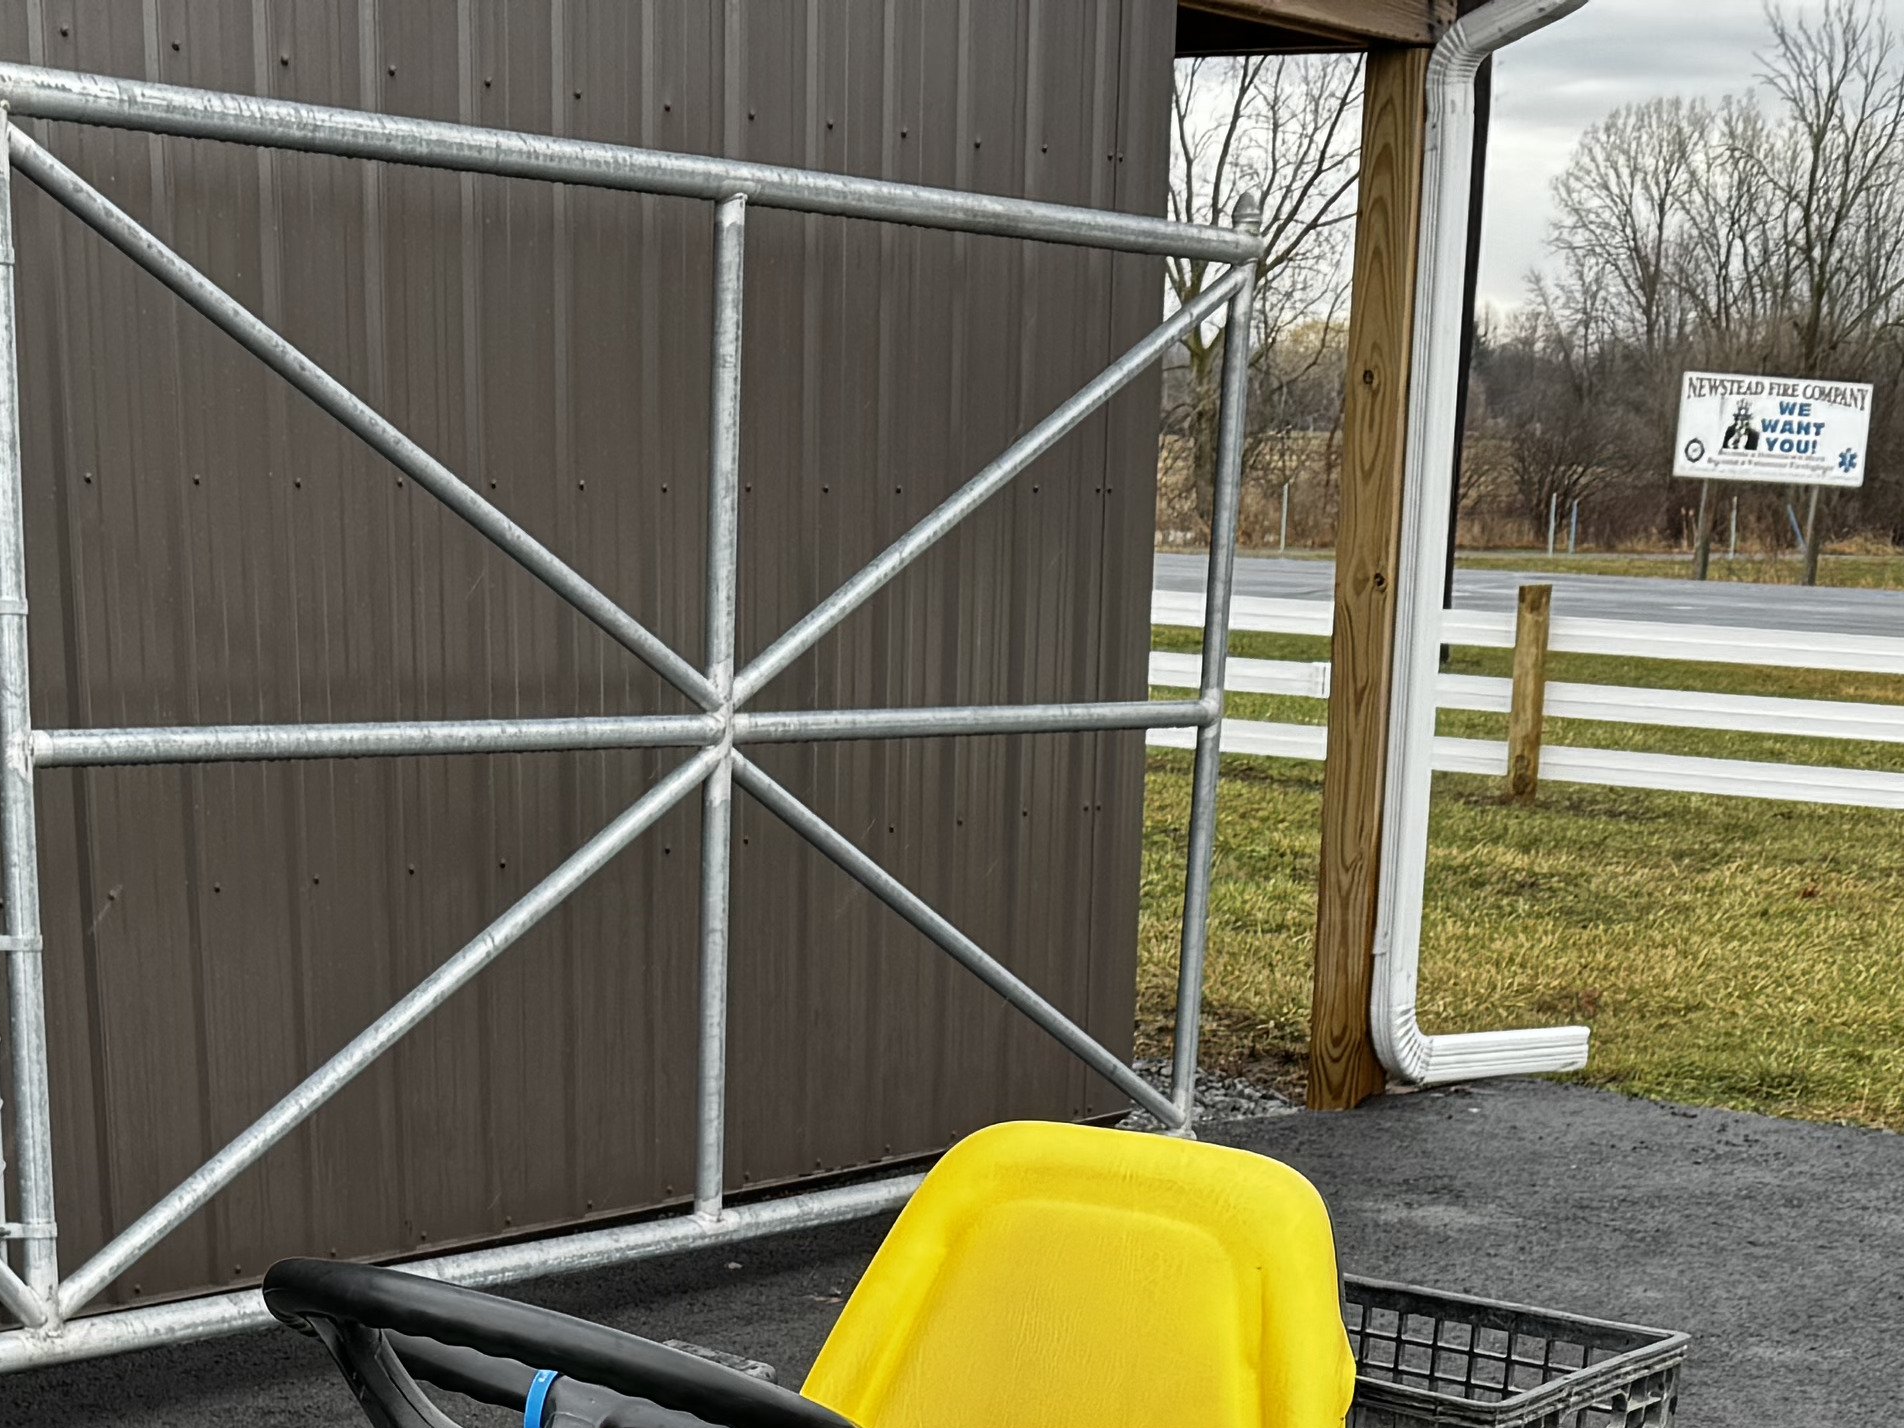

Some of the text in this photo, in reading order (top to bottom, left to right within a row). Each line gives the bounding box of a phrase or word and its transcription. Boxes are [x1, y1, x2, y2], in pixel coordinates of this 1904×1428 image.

[1687, 376, 1869, 411] NEWSTEAD FIRE COMPANY
[1779, 401, 1812, 417] WE
[1761, 418, 1825, 436] WANT
[1765, 437, 1818, 455] YOU!
